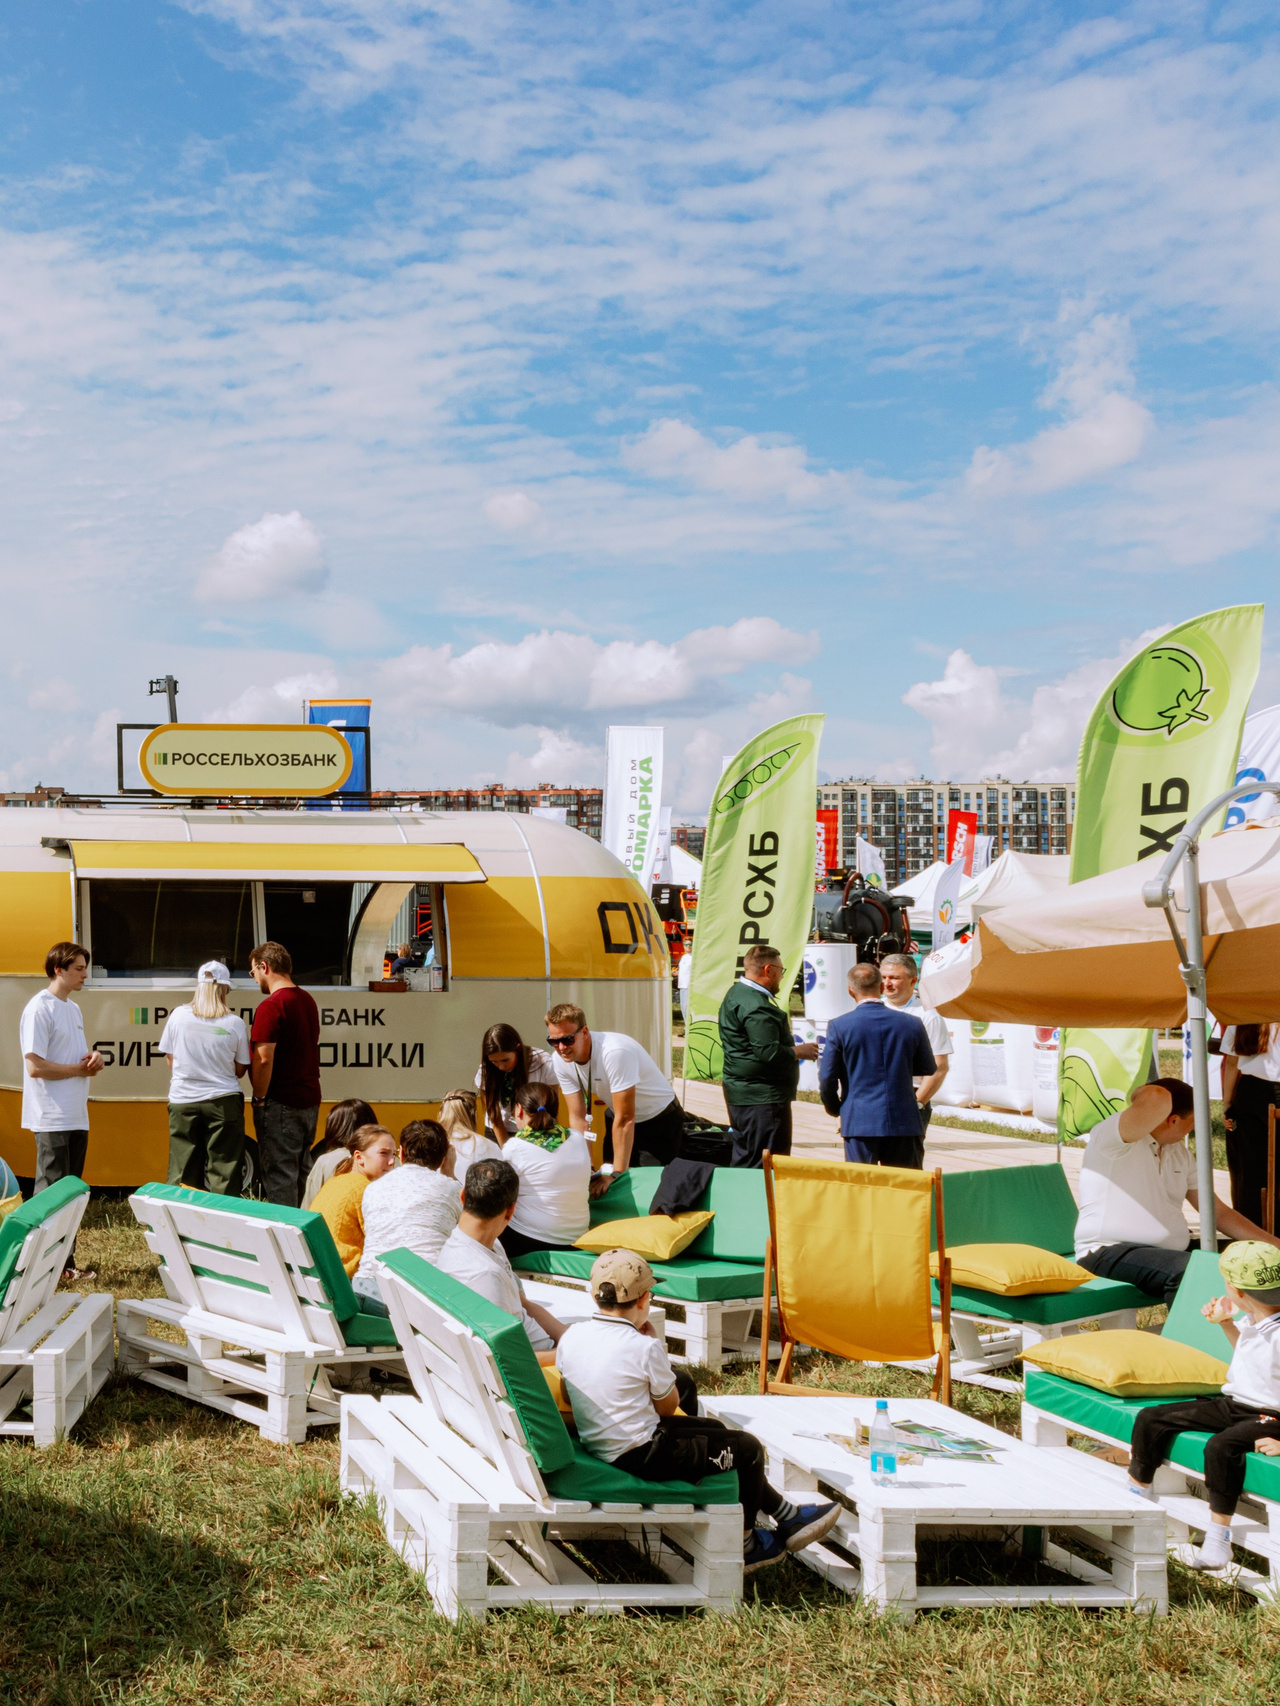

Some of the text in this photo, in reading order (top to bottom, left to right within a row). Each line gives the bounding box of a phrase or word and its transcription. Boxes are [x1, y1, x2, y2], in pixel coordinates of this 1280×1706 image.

[171, 752, 337, 766] РОССЕЛЬХОЗБАНК
[625, 759, 638, 867] ОВЫЙ ДОМ
[629, 756, 653, 874] ОМАРКА
[951, 822, 968, 860] RSCH
[1137, 777, 1190, 862] ХБ
[815, 822, 826, 879] HORSCH
[738, 830, 779, 945] РСХБ
[318, 1042, 425, 1068] ОШКИ
